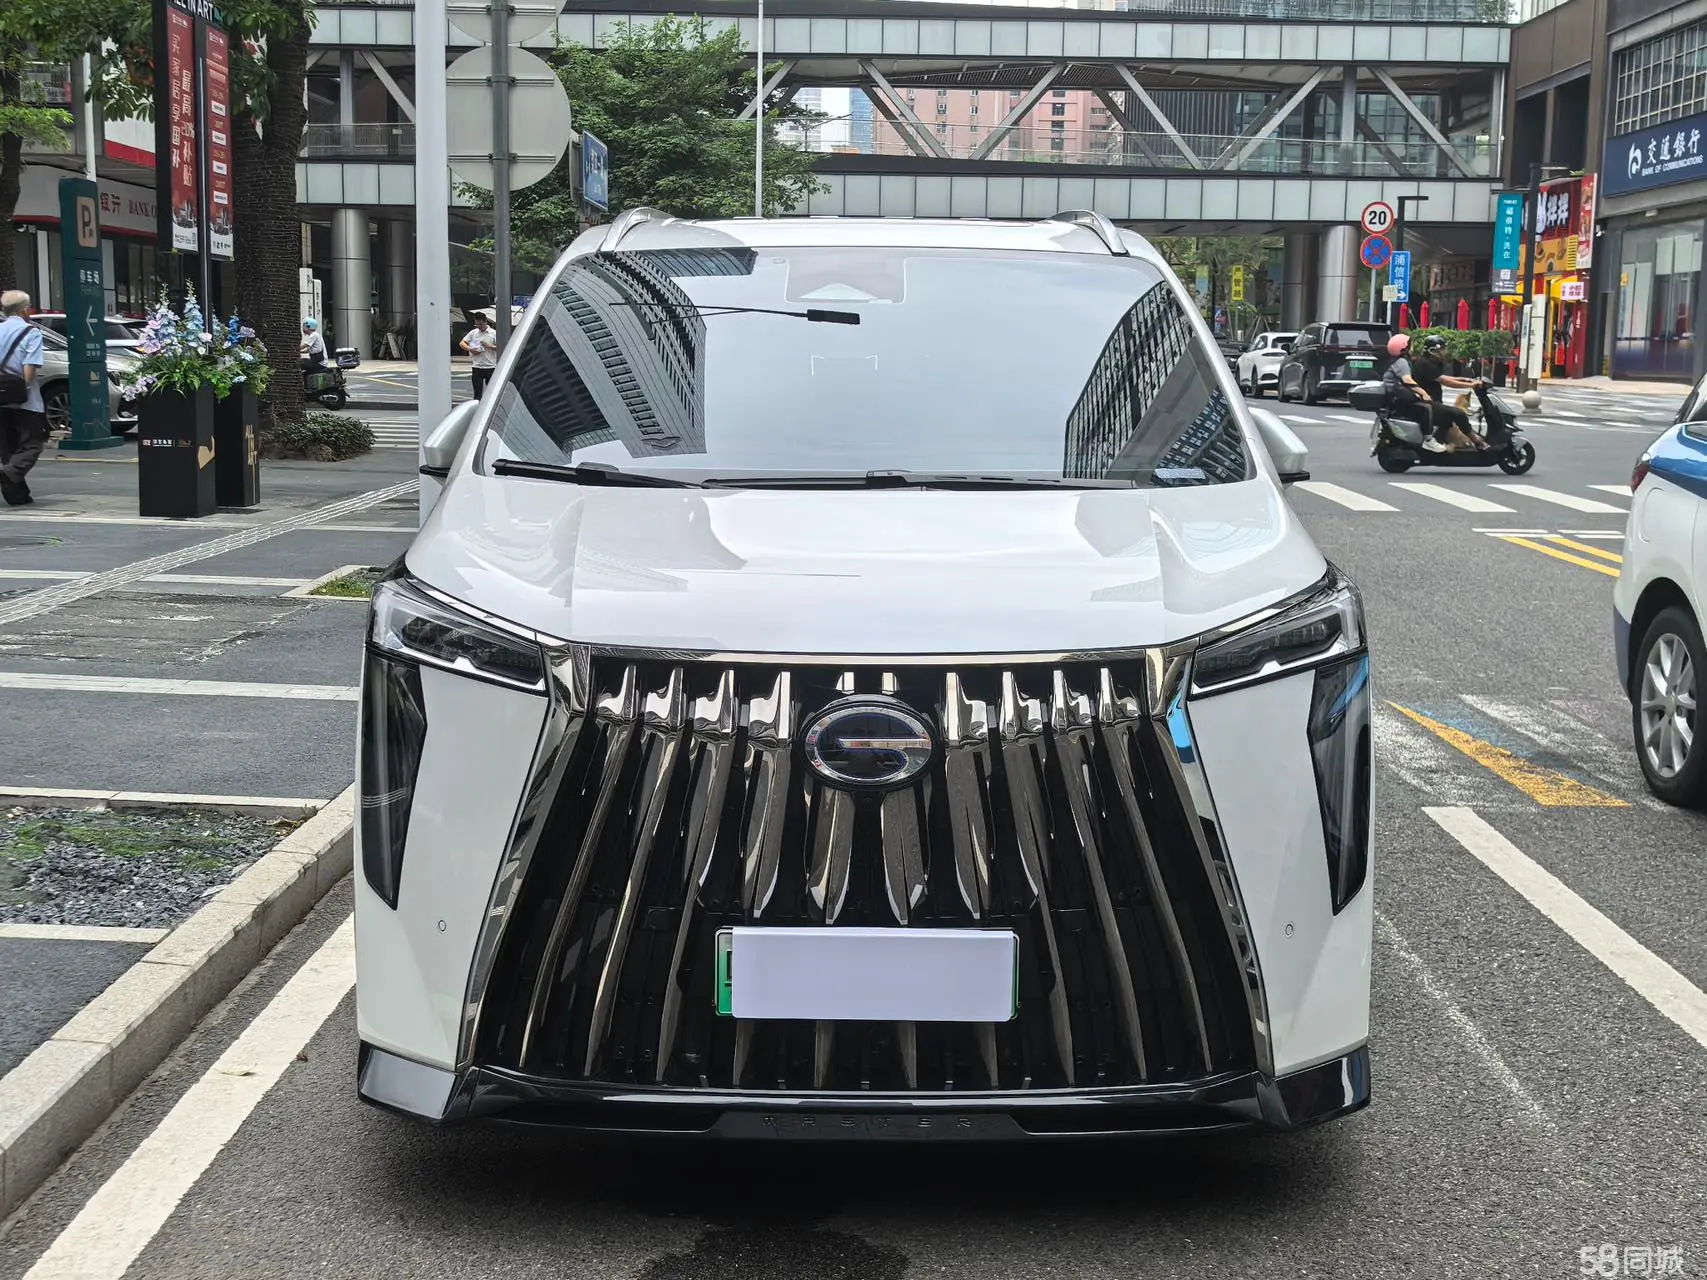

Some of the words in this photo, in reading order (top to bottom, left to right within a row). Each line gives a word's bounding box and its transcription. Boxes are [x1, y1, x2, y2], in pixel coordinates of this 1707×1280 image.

[196, 0, 214, 23] ART
[1641, 167, 1654, 177] BANK
[1654, 164, 1662, 174] OF
[1662, 154, 1704, 172] COMMUNICATIONS
[128, 199, 151, 218] BANK
[1368, 210, 1387, 226] 20
[81, 204, 92, 239] P
